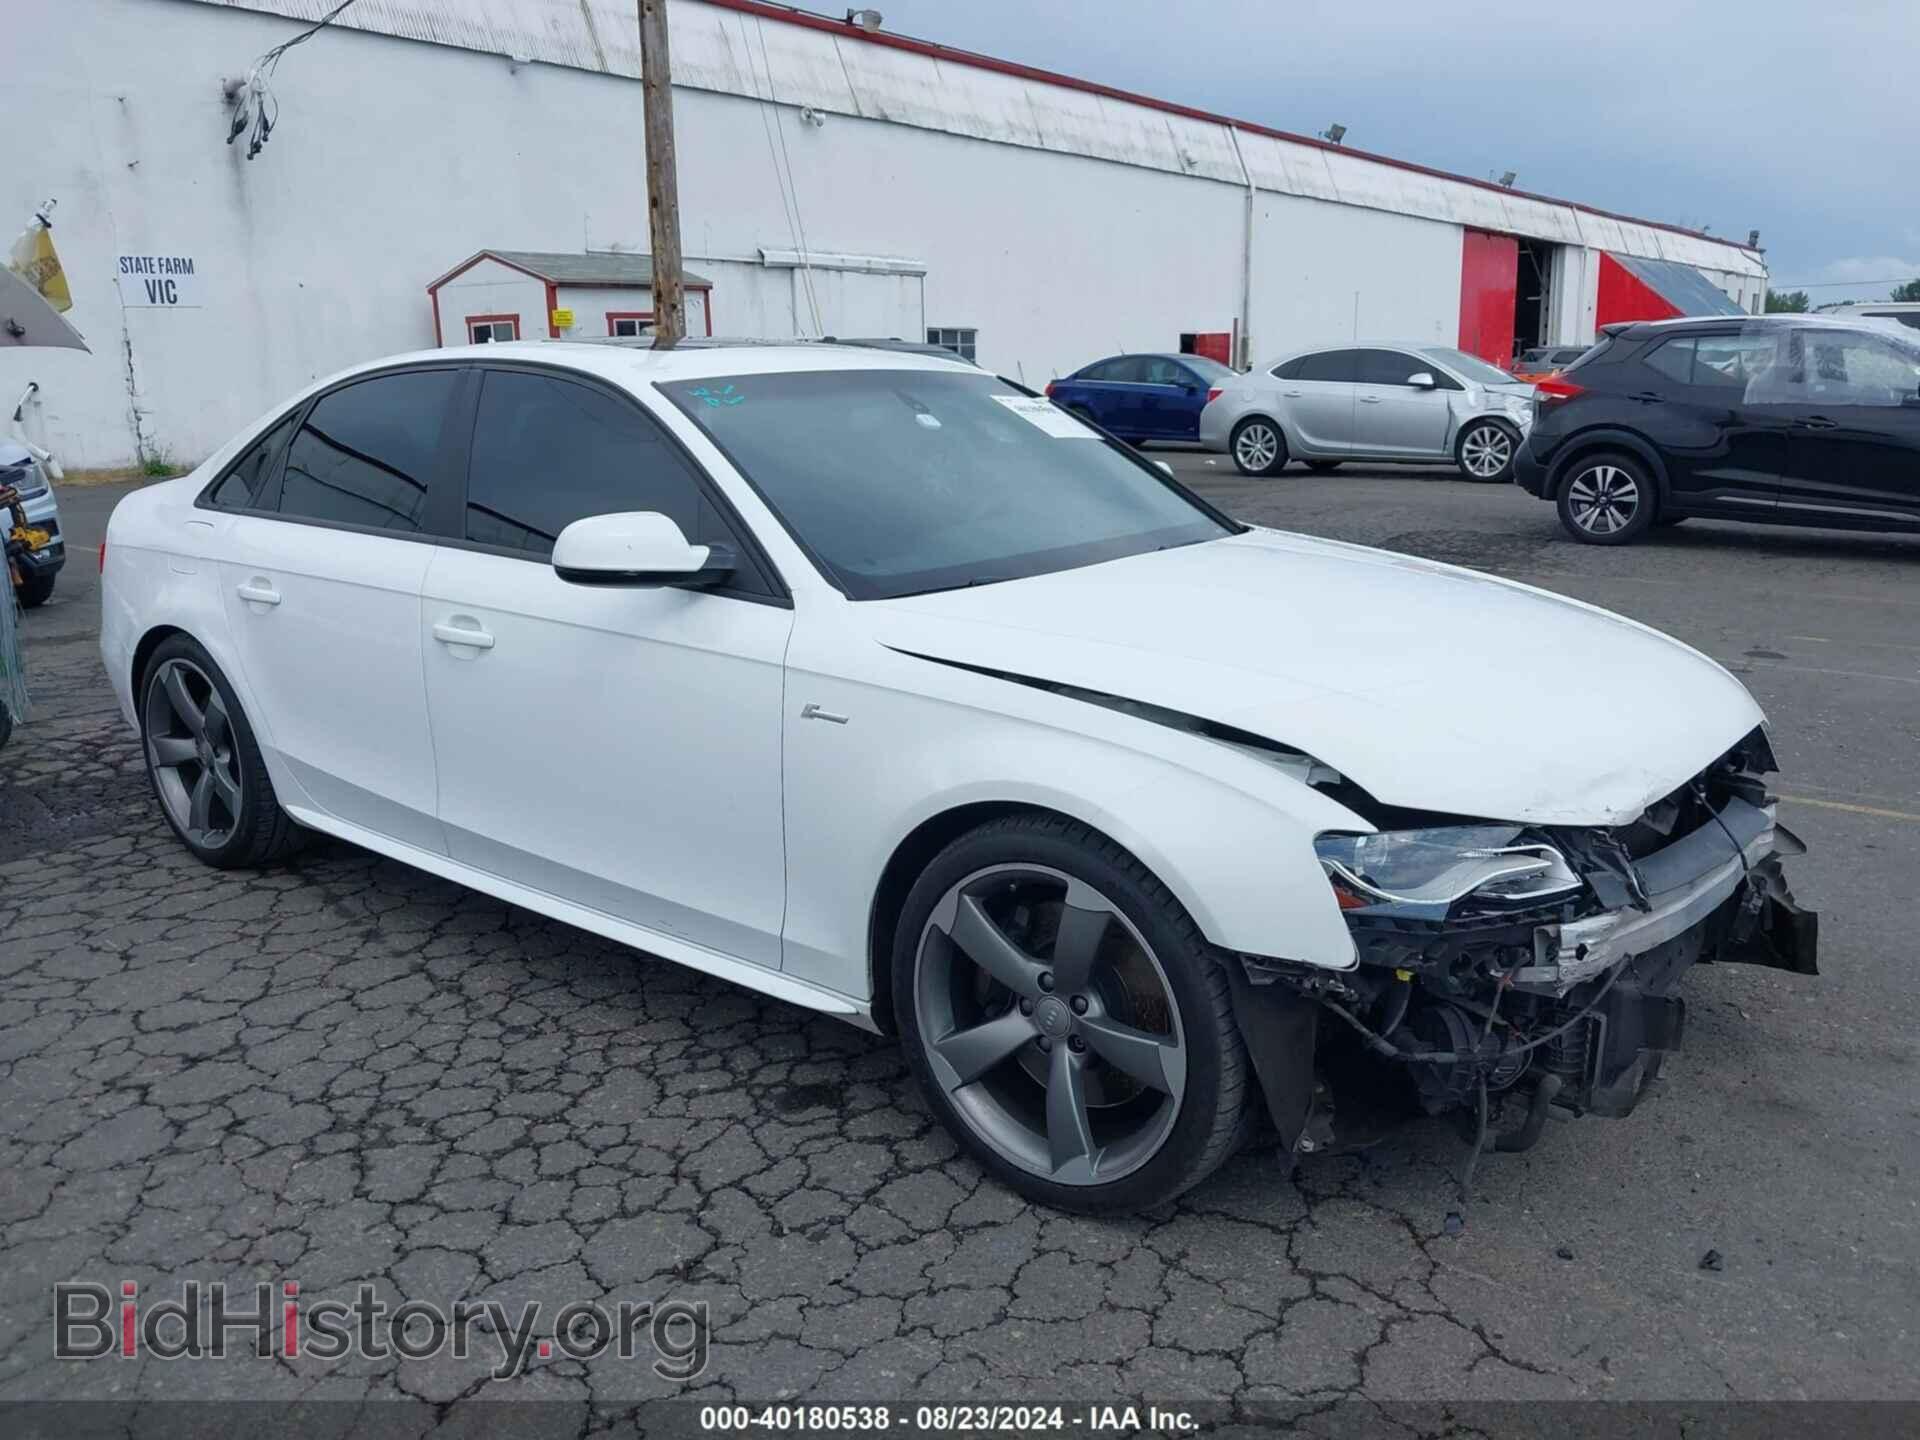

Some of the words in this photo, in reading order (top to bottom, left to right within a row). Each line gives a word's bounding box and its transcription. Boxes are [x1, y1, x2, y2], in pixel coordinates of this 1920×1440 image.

[120, 256, 155, 274] STATE
[158, 257, 194, 275] FARM
[145, 279, 177, 304] VIC
